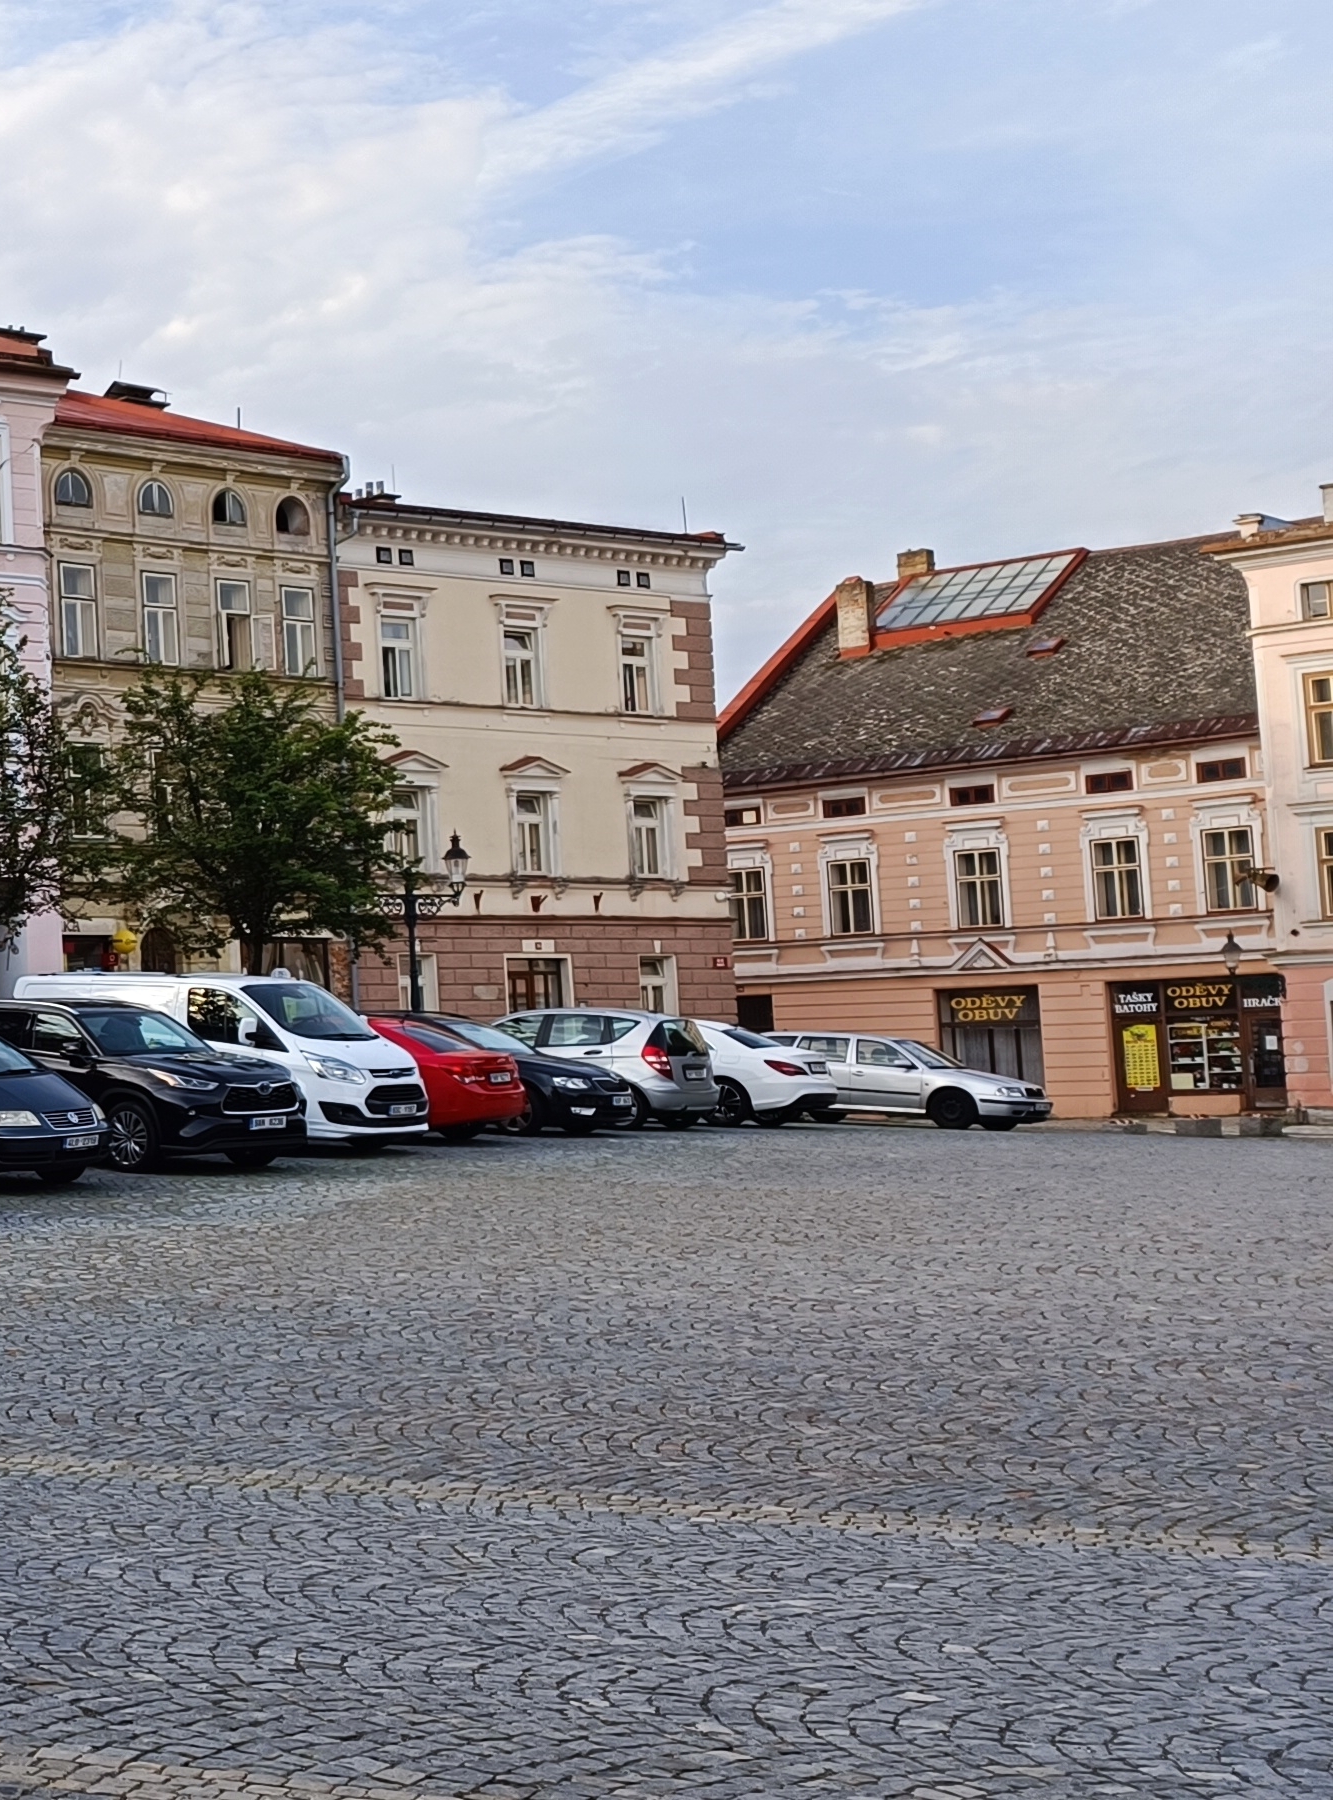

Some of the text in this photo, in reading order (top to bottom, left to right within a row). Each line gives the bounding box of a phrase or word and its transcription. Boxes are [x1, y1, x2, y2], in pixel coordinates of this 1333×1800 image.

[1166, 983, 1233, 997] ODĚVY
[950, 993, 1026, 1009] ODĚVY
[1118, 991, 1153, 1003] TAŠKY
[1174, 996, 1227, 1009] OBUV
[1243, 995, 1282, 1008] HRAČK
[958, 1008, 1019, 1021] OBUV
[1115, 1002, 1159, 1014] BATOHY
